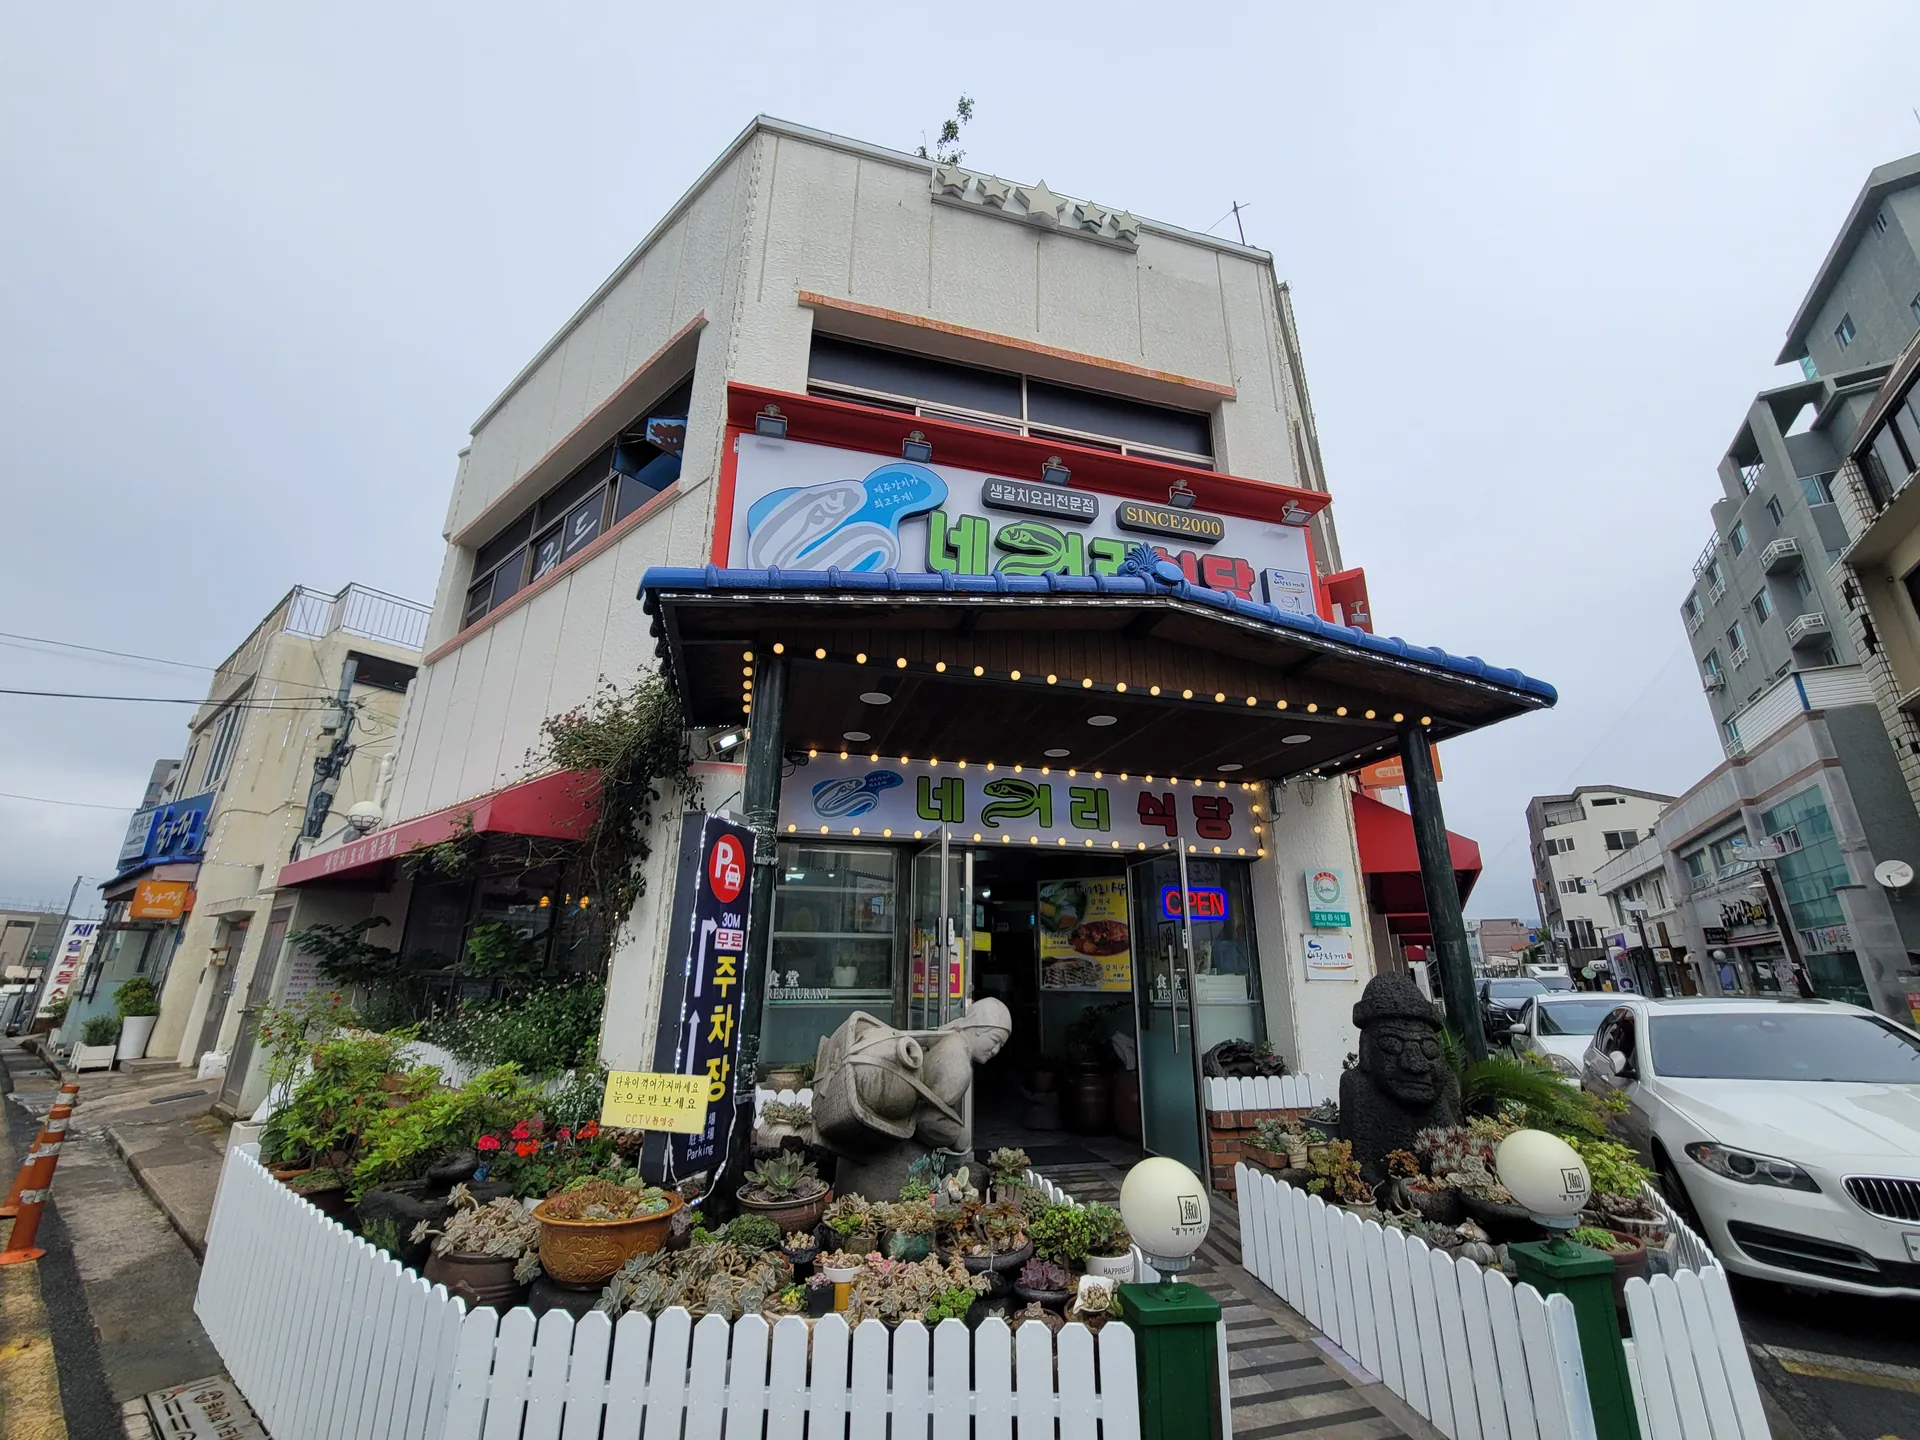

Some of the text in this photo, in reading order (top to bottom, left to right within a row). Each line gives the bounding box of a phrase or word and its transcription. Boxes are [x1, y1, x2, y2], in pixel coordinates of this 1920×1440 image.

[990, 483, 1095, 514] 생갈치요리전문점
[1126, 506, 1221, 536] SINCE2000
[916, 775, 1234, 840] 네거리 식당
[1165, 890, 1225, 916] OPEN
[721, 912, 741, 929] 30M
[1314, 913, 1347, 922] 모범음식점
[717, 930, 743, 949] 무료
[768, 969, 800, 988] 食堂
[767, 987, 831, 1000] RESTAURANT
[705, 955, 737, 1102] 주차장
[616, 1075, 640, 1090] 다육이
[613, 1090, 697, 1110] 눈으로만 보세요
[686, 1144, 714, 1161] Parking
